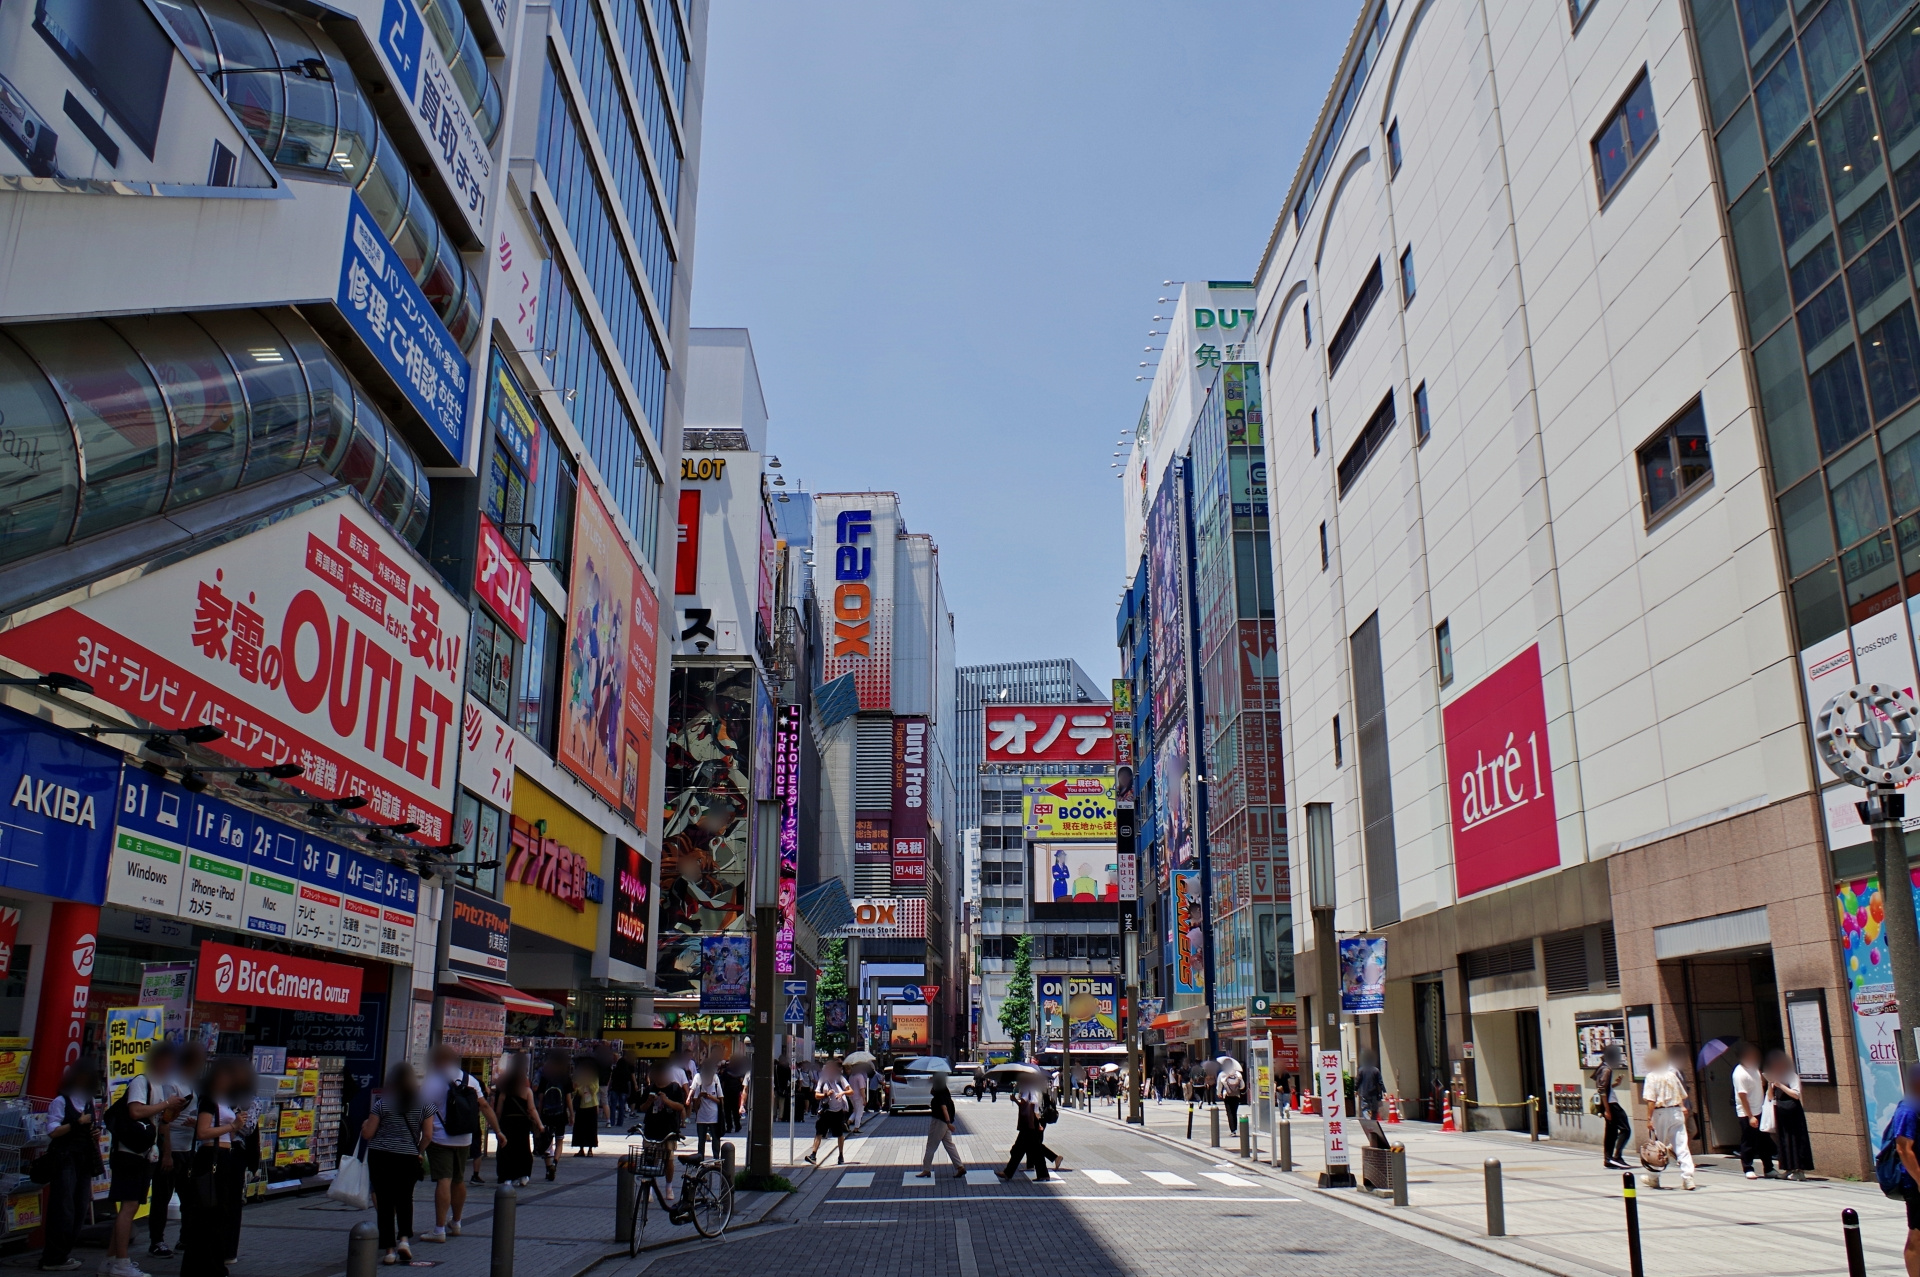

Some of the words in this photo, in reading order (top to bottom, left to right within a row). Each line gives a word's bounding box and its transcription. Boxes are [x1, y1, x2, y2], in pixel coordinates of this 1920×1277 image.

[426, 47, 489, 178] パソコン・スマホ・カメラ
[419, 69, 486, 227] 買取ます!
[348, 256, 436, 410] 修理・ご相談
[383, 264, 465, 393] パソコン・スマホ・家電の
[436, 380, 463, 426] お任せ
[437, 408, 460, 441] ください
[0, 429, 45, 472] ank
[348, 532, 370, 562] 展示品
[314, 548, 345, 584] 再調整品
[377, 562, 407, 595] 外装不良品
[481, 532, 525, 624] アコム
[351, 582, 383, 616] 生産完了品
[385, 613, 409, 645] だから
[408, 583, 461, 685] 安い!
[1855, 642, 1877, 658] Cross
[1876, 632, 1898, 648] Store
[73, 635, 180, 717] 3F:テレビ
[1811, 662, 1830, 676] BANDAI
[1829, 654, 1849, 670] NAMCO
[191, 567, 284, 691] 家電の
[280, 588, 454, 791] OUTLET
[896, 723, 905, 760] Flagship
[903, 722, 926, 762] Duty
[777, 732, 786, 796] TRANCE
[896, 762, 905, 788] Store
[906, 767, 926, 808] Free
[1077, 779, 1100, 788] 現在地
[1461, 731, 1524, 825] atré
[1527, 730, 1545, 801] 1
[11, 774, 96, 830] AKIBA
[124, 783, 149, 818] B1
[1036, 804, 1052, 813] ここ!
[1058, 806, 1116, 819] BOOK・
[195, 803, 215, 838] 1F
[856, 821, 872, 830] 本店
[125, 837, 143, 851] 中古
[253, 826, 272, 858] 2F
[855, 830, 889, 839] 総合家電
[896, 841, 923, 854] 免税
[195, 858, 210, 870] 中古
[303, 844, 320, 873] 3F
[895, 865, 923, 875] 면세점
[127, 860, 168, 885] Windows
[347, 860, 363, 887] 4F
[386, 873, 399, 898] 5F
[191, 877, 235, 902] iPhone・iPad
[189, 898, 213, 916] カメラ
[262, 897, 277, 912] Mac
[298, 904, 317, 921] テレビ
[453, 901, 509, 934] アクセスチケット
[296, 921, 325, 939] レコーダー
[341, 932, 362, 949] エアコン
[488, 931, 508, 953] 秋葉原店
[877, 926, 897, 935] Store
[1175, 873, 1194, 990] GAMERS
[778, 963, 793, 972] 3台
[237, 959, 323, 1001] BicCamera
[324, 986, 350, 1003] OUTLET
[1043, 982, 1113, 995] ONODEN
[111, 1021, 127, 1036] 中古
[289, 1026, 365, 1038] パソコン・スマホ
[677, 1014, 745, 1032] 戦国乙女
[1043, 1027, 1114, 1038] AKIBARA
[110, 1039, 151, 1057] iPhone
[635, 1041, 669, 1049] ライオン
[109, 1060, 135, 1077] iPad
[1325, 1072, 1344, 1152] ライブ禁止
